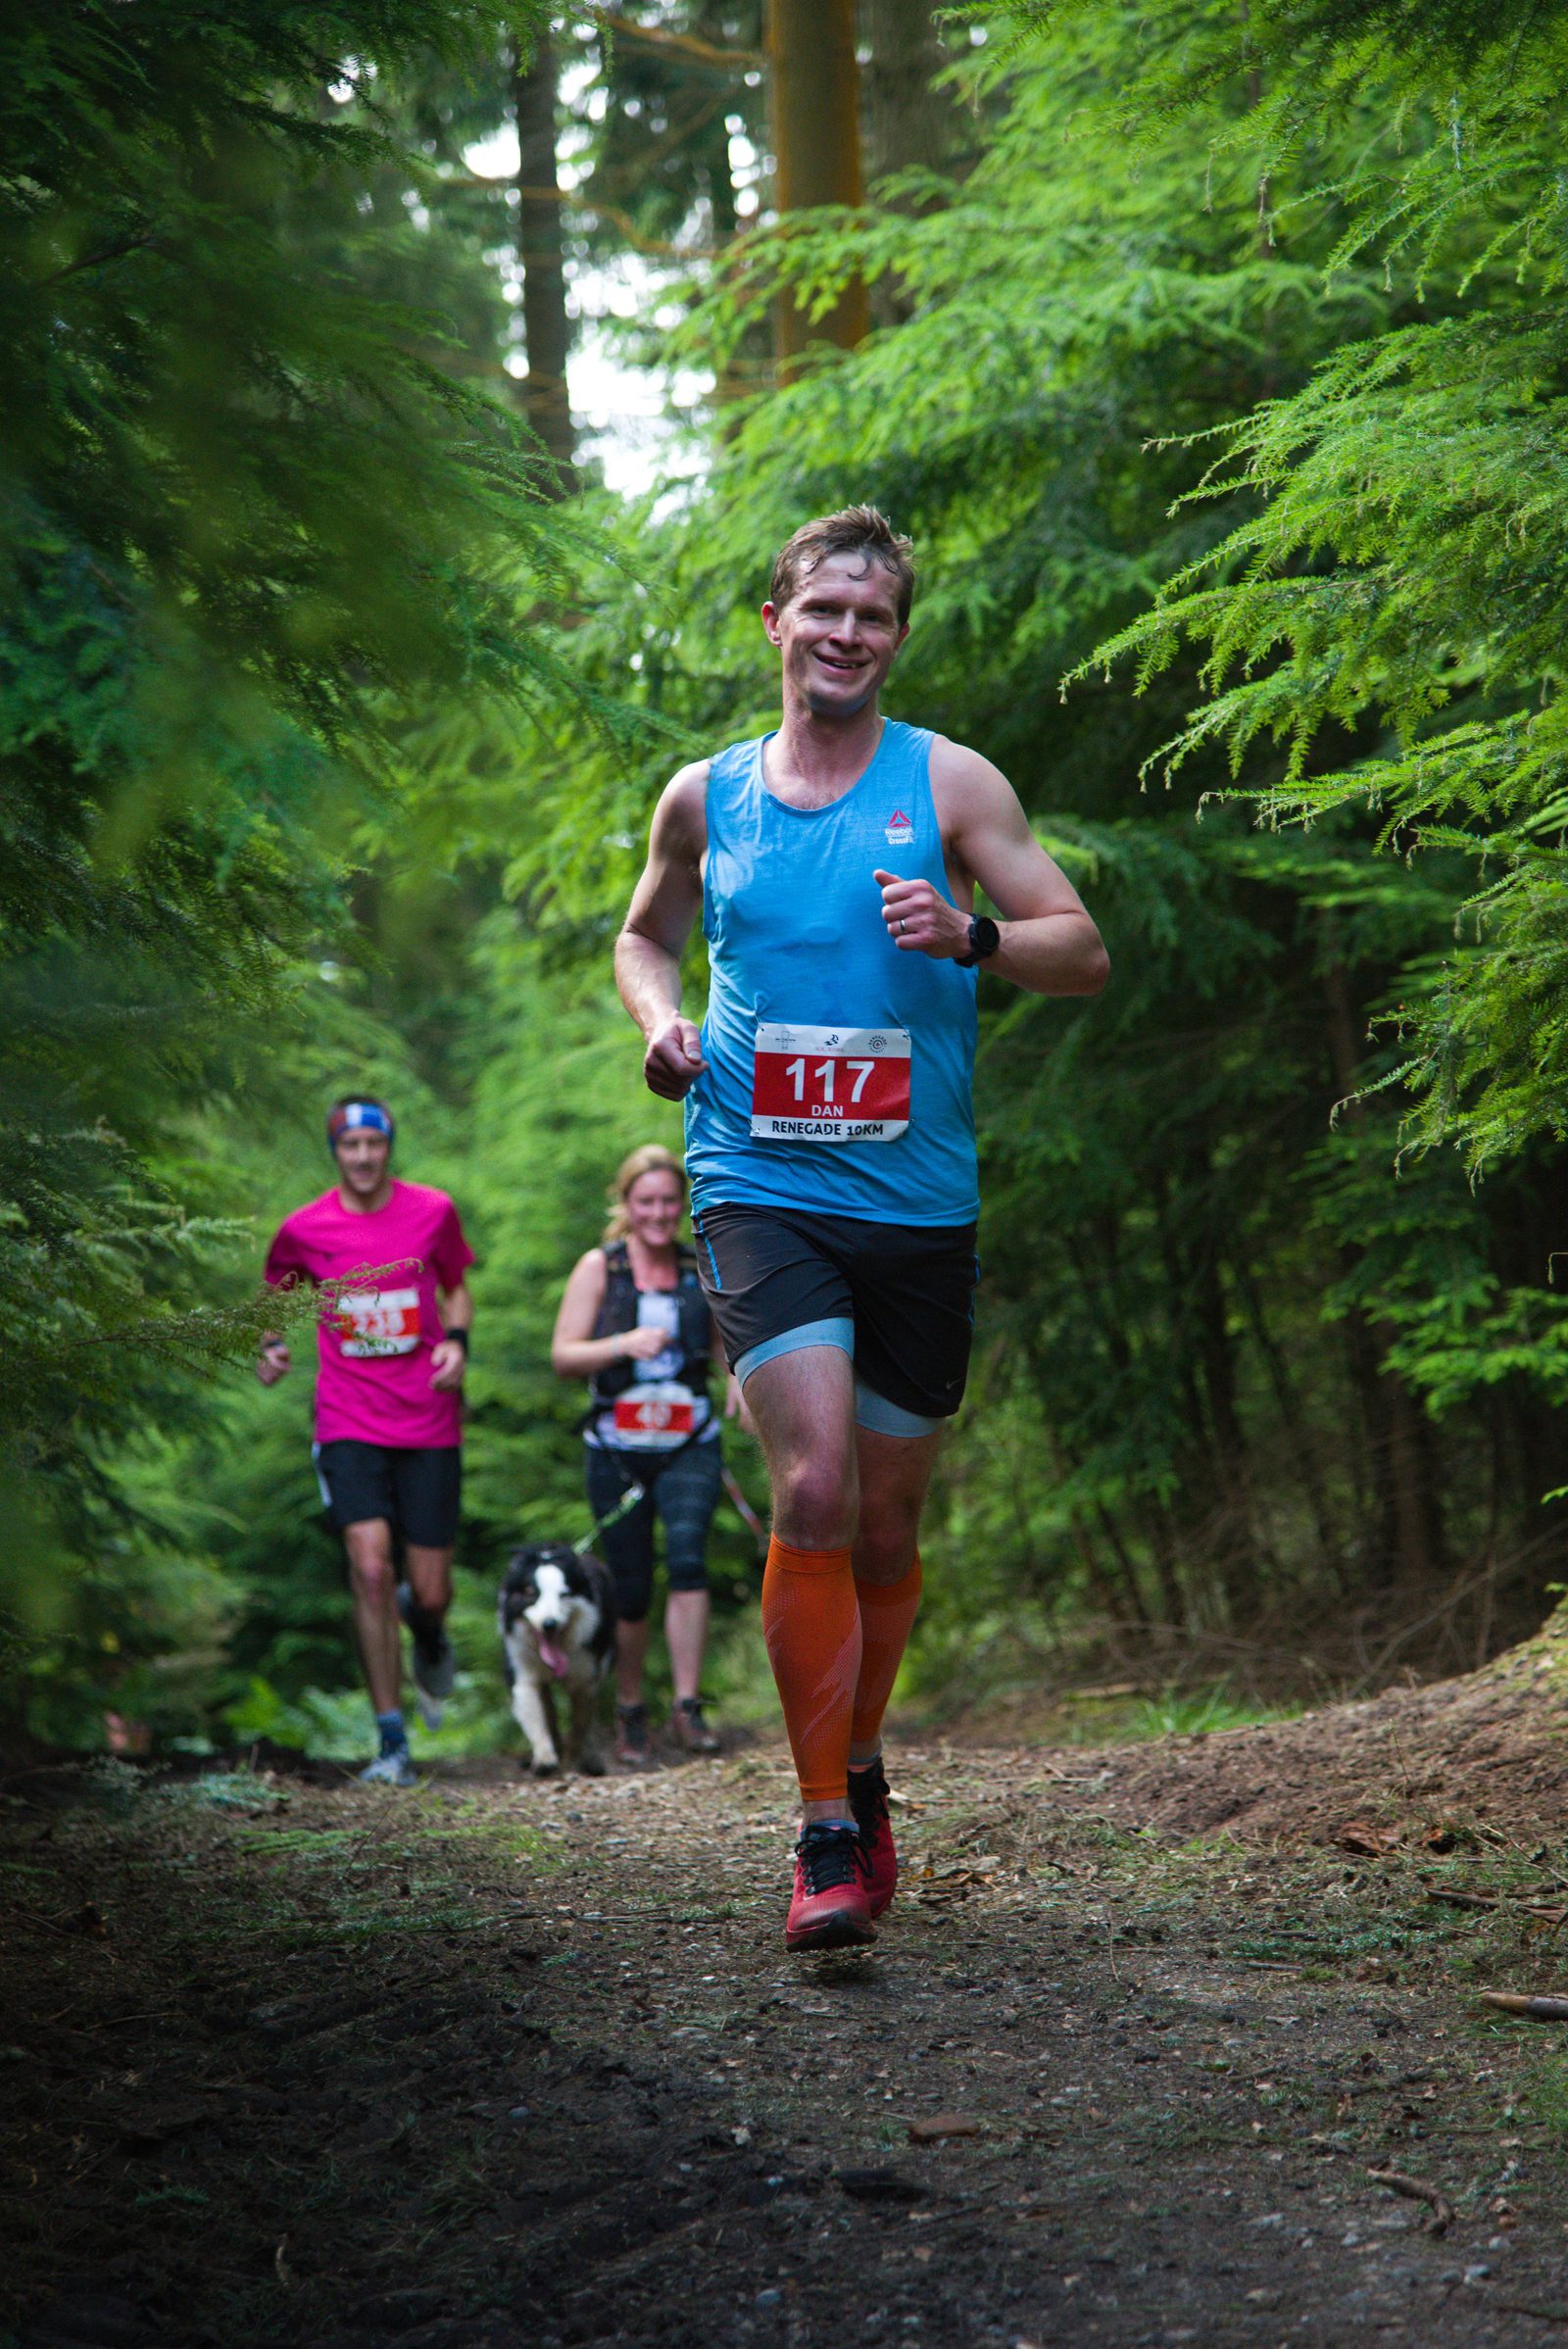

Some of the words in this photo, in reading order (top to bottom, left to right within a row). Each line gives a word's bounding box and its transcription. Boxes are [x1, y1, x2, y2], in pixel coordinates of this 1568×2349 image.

[786, 1058, 875, 1102] 117
[811, 1104, 844, 1117] DAN
[772, 1121, 842, 1136] RENEGADE
[847, 1124, 884, 1136] 10KM
[635, 1402, 672, 1428] 40
